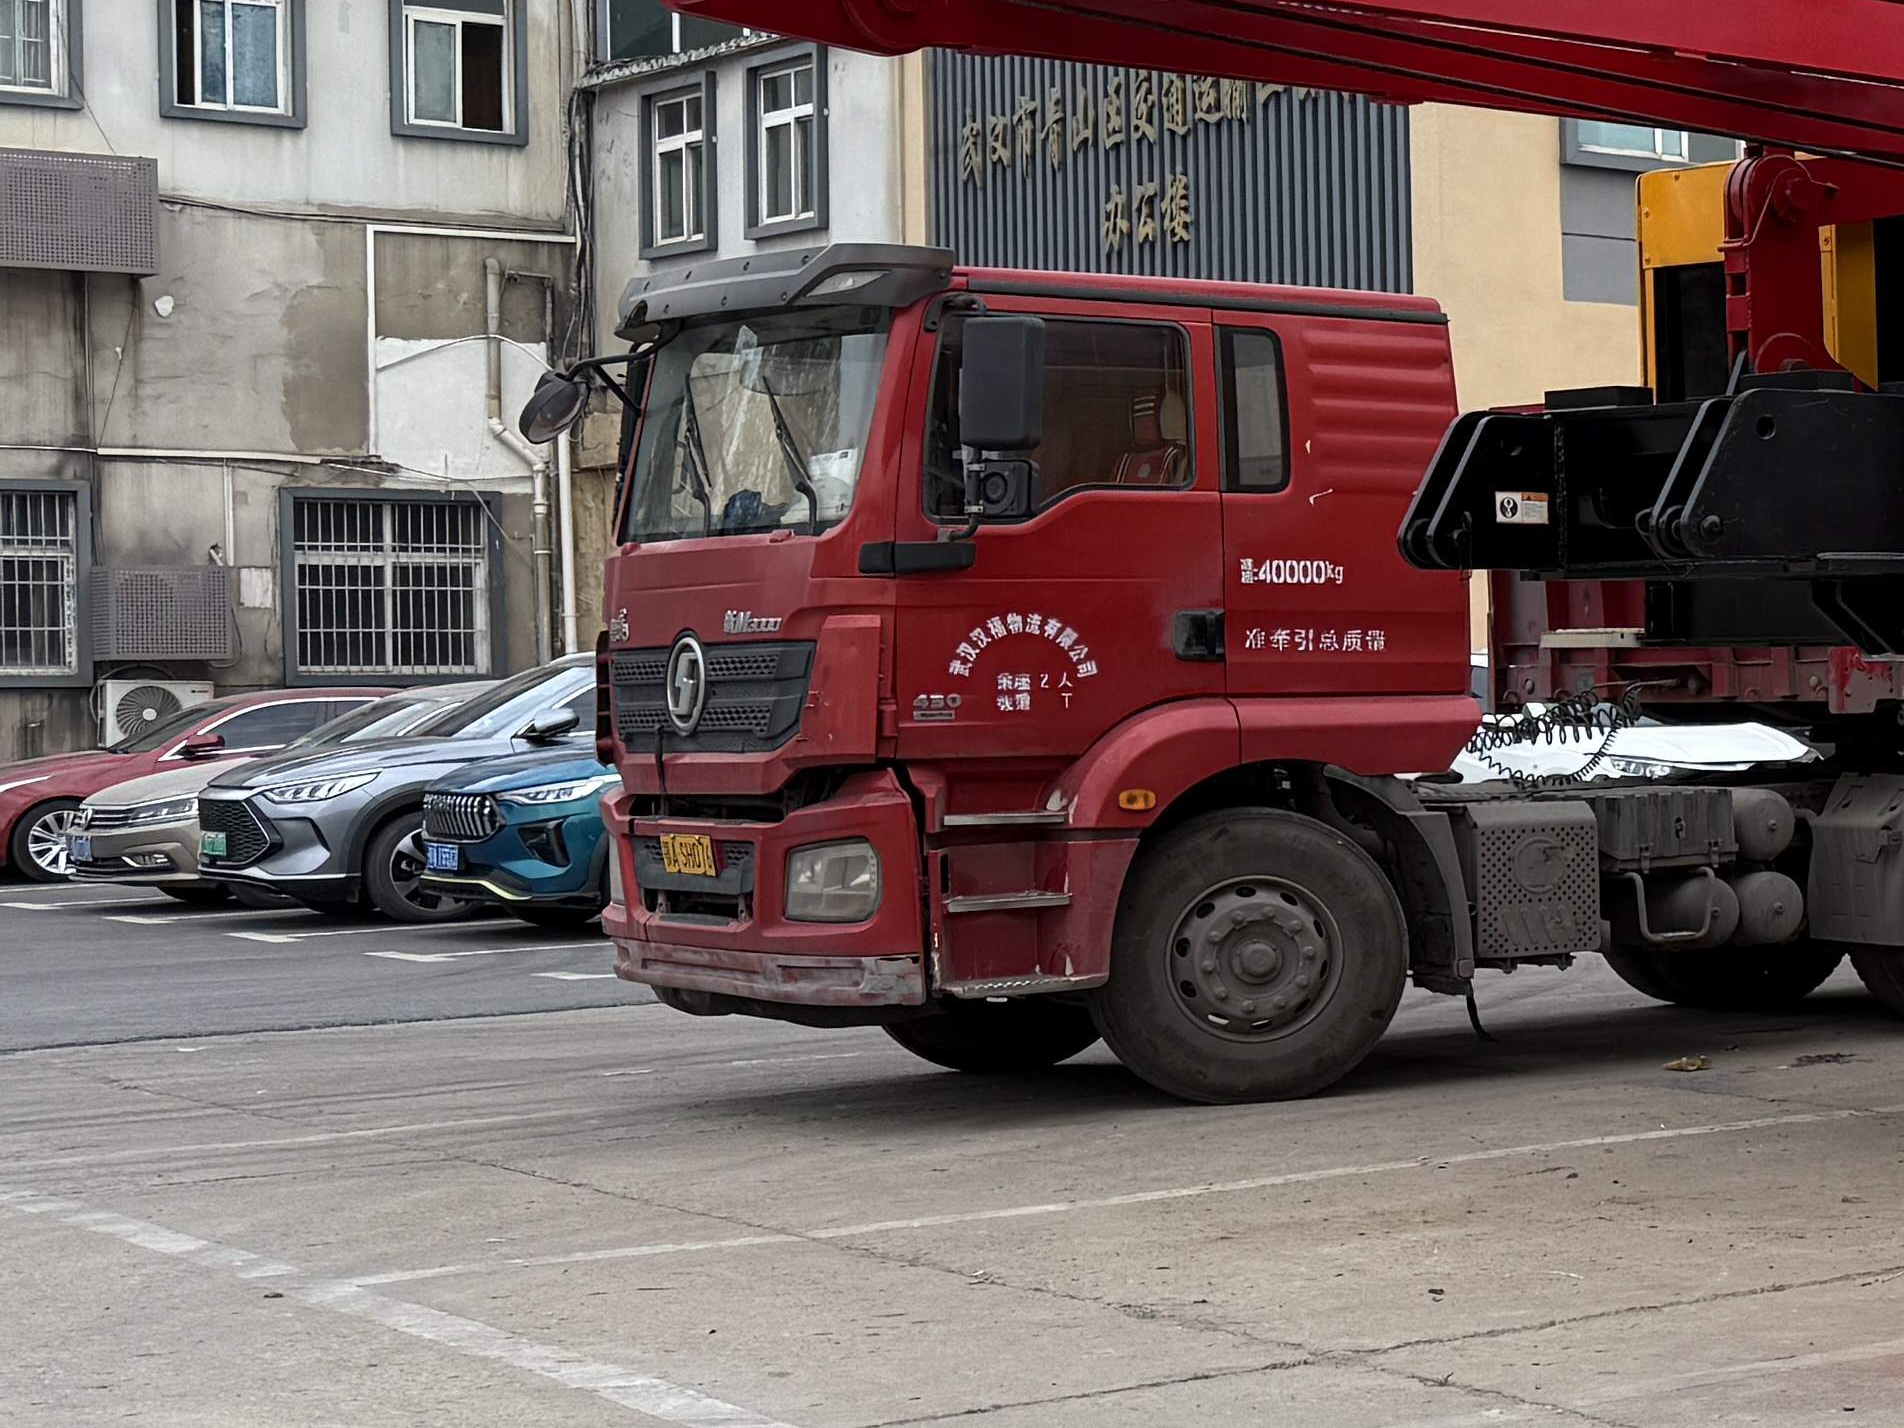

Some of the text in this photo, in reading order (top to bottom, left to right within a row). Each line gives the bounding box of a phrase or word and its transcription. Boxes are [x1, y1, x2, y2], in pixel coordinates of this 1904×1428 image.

[1102, 166, 1192, 255] 办公楼
[1040, 674, 1049, 689] 2
[1058, 672, 1073, 688] 人
